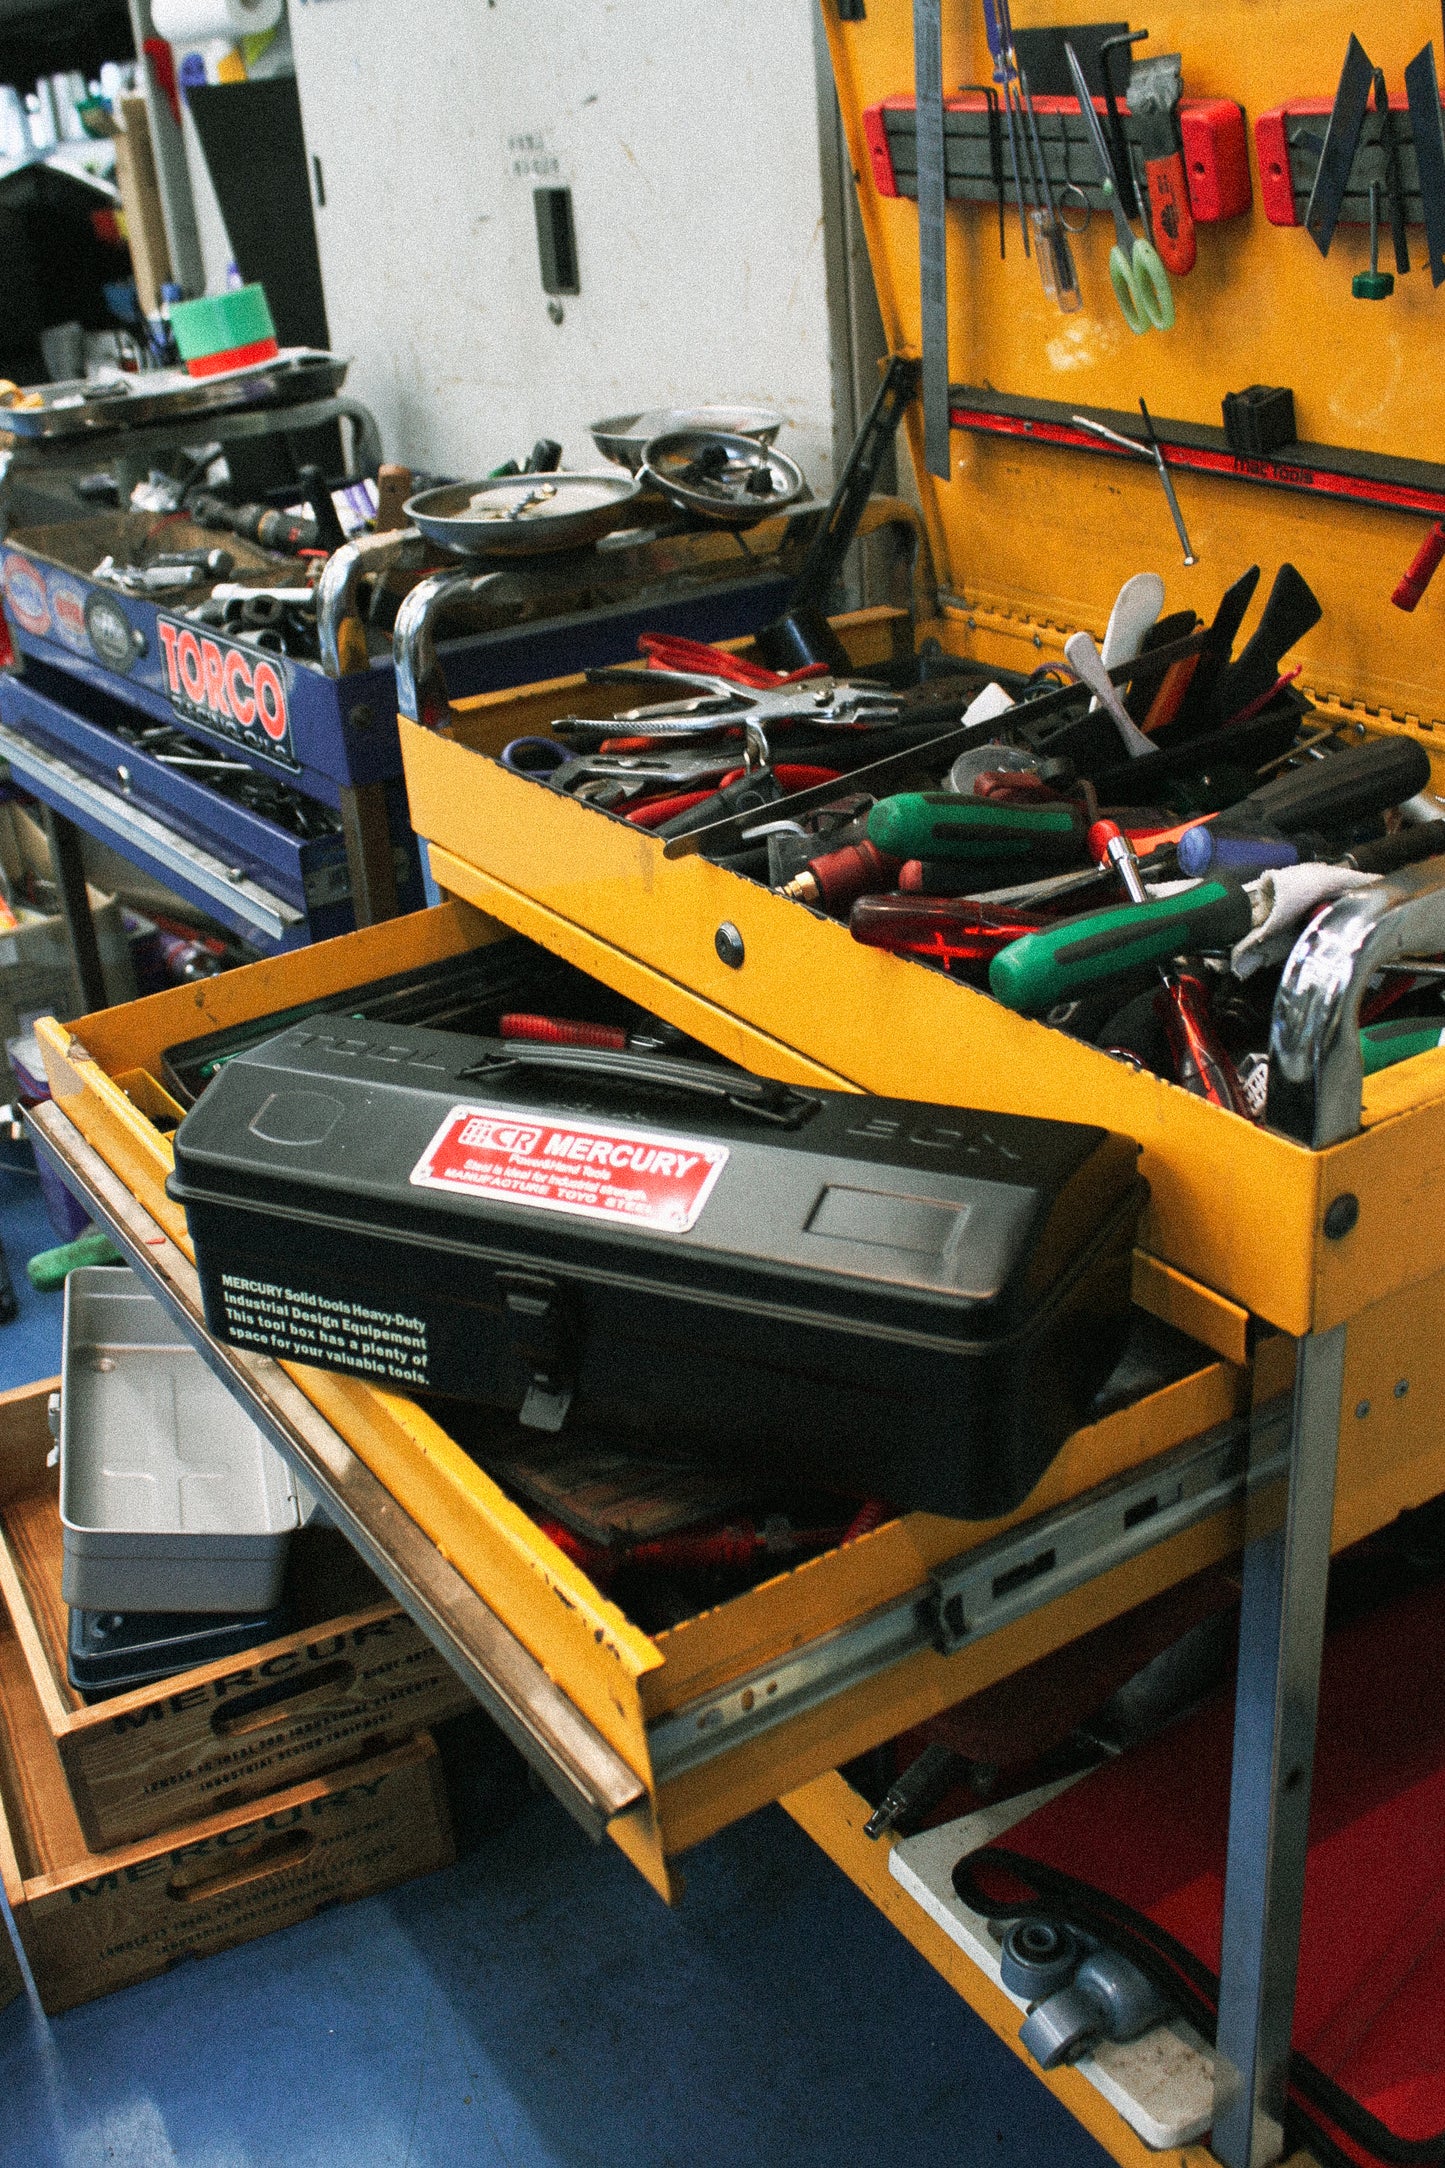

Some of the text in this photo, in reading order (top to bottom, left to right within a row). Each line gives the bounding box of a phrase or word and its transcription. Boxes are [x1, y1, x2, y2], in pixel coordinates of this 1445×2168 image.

[159, 622, 287, 741] TORCO
[542, 1133, 700, 1178] MERCURY
[444, 1168, 550, 1195] MANUFACTURE
[558, 1187, 598, 1203] TOYO
[222, 1274, 426, 1333] MERCURY Solid tools Heavy-Duty
[224, 1291, 427, 1350] Industrial Design Equipement
[225, 1307, 428, 1367] This tool box has a plenty of
[229, 1327, 430, 1385] space for your valuable tools.
[112, 1614, 414, 1736] MERCUR
